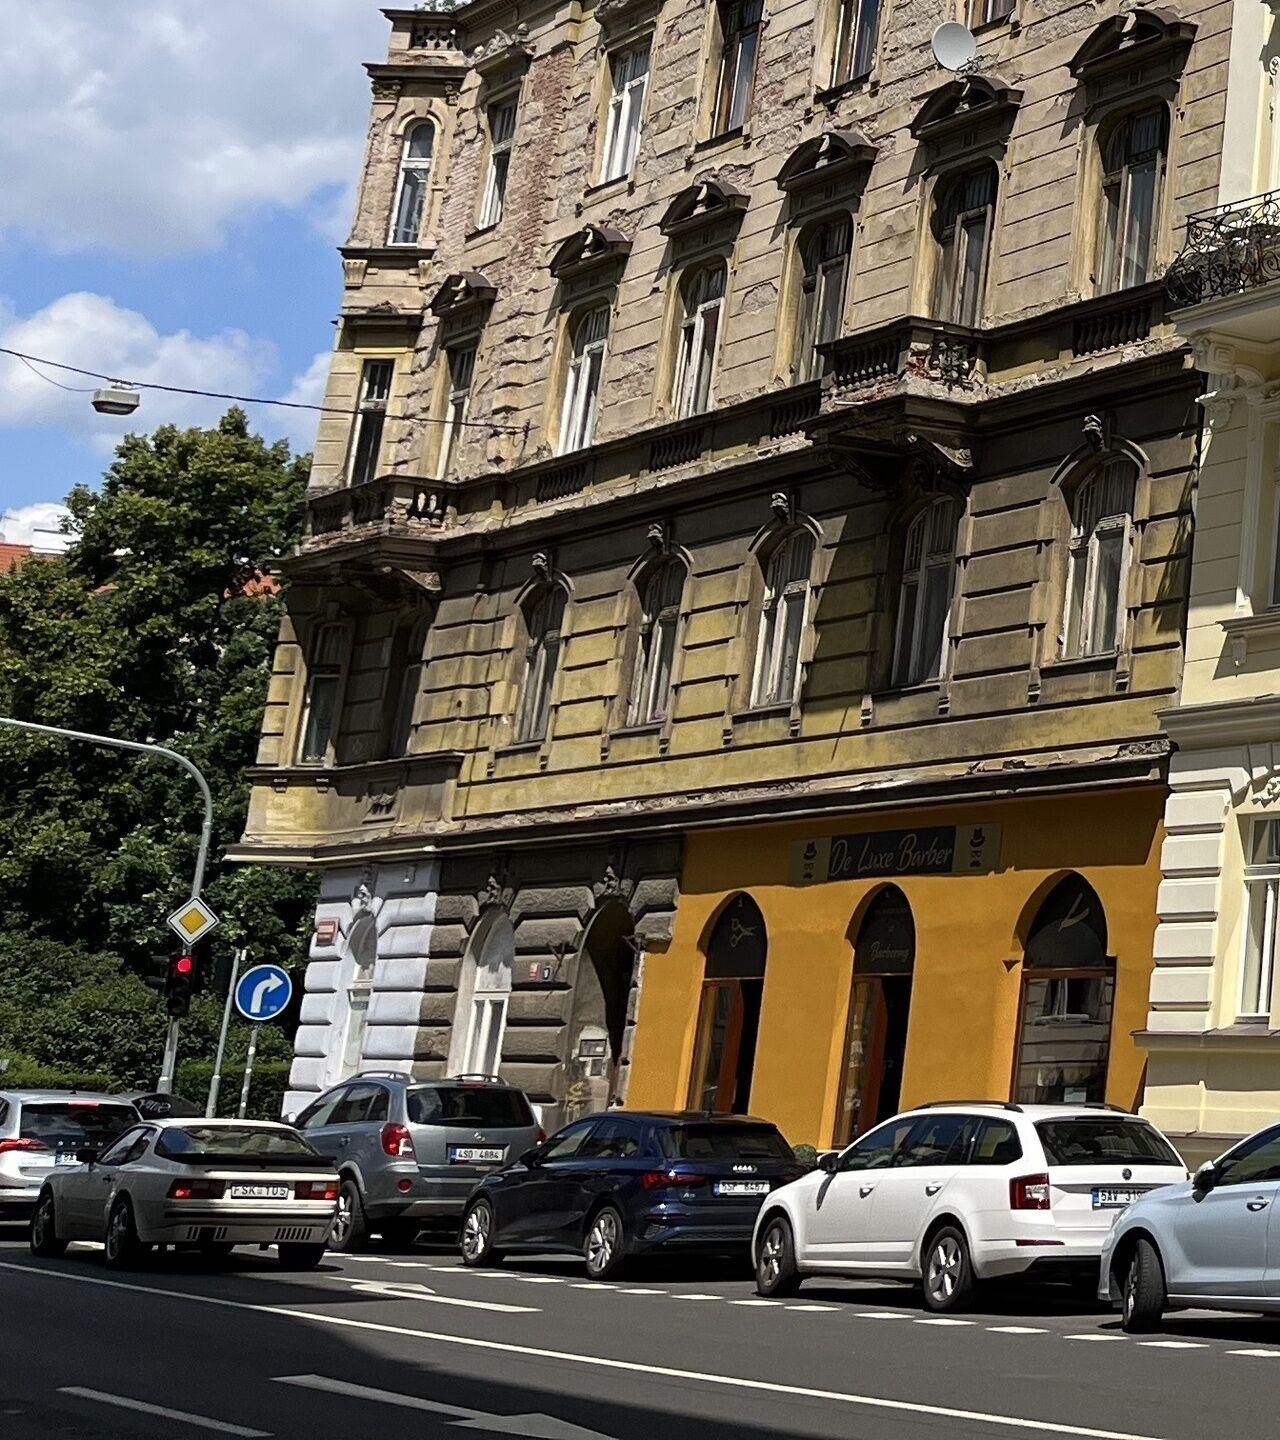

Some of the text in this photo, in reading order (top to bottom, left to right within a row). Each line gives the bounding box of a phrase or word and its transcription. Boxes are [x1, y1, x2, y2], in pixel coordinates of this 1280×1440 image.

[831, 833, 952, 876] De Luxe Barber
